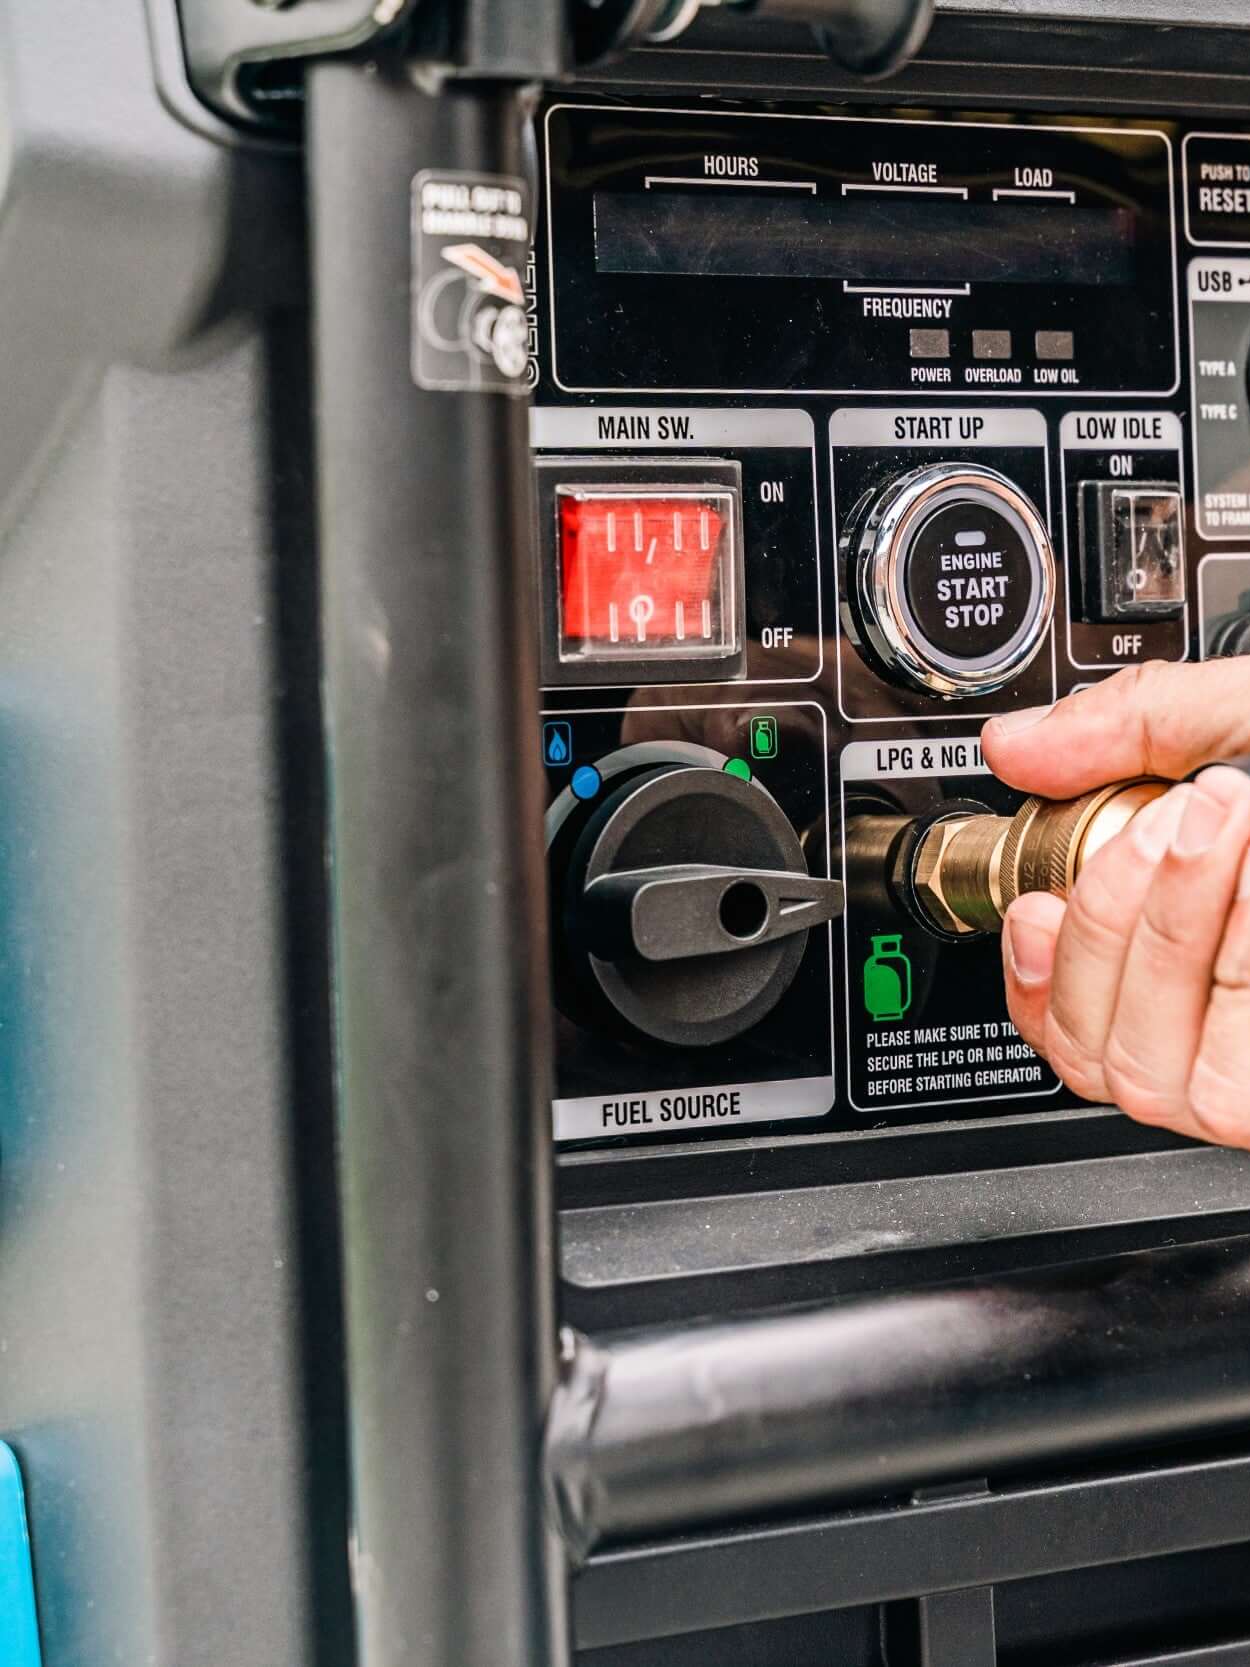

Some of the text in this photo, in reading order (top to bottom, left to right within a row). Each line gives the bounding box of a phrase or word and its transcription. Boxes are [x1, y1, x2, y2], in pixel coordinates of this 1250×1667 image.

[704, 155, 759, 177] HOURS
[872, 162, 937, 184] VOLTAGE
[1201, 164, 1250, 182] PUSH TO
[1015, 167, 1053, 188] LOAD
[1198, 271, 1232, 292] USB
[863, 297, 953, 319] FREQUENCY
[911, 367, 951, 383] POWER
[965, 367, 1022, 384] OVERLOAD
[1034, 368, 1079, 384] LOW OIL
[1199, 361, 1236, 376] TYPE A
[1200, 404, 1238, 420] TYPE C
[598, 415, 695, 440] MAIN SW.
[894, 416, 984, 440] START UP
[1076, 417, 1162, 440] LOW IDLE
[1109, 455, 1133, 477] ON
[760, 481, 784, 502] ON
[1205, 493, 1248, 508] SYSTEM
[1205, 510, 1220, 526] TO
[941, 551, 1002, 572] ENGINE
[937, 575, 1009, 602] START
[945, 603, 1004, 629] STOP
[761, 627, 794, 649] OFF
[1112, 635, 1142, 656] OFF
[877, 747, 913, 771] LPG
[920, 746, 933, 769] &
[941, 745, 967, 768] NG
[866, 1029, 911, 1049] PLEASE
[914, 1027, 947, 1045] MAKE
[949, 1024, 981, 1042] SURE
[983, 1022, 999, 1038] TO
[867, 1043, 1036, 1072] SECURE THE LPG OR NG HOSE
[868, 1065, 1042, 1096] BEFORE STARTING GENERATOR
[601, 1091, 741, 1127] FUEL SOURCE
